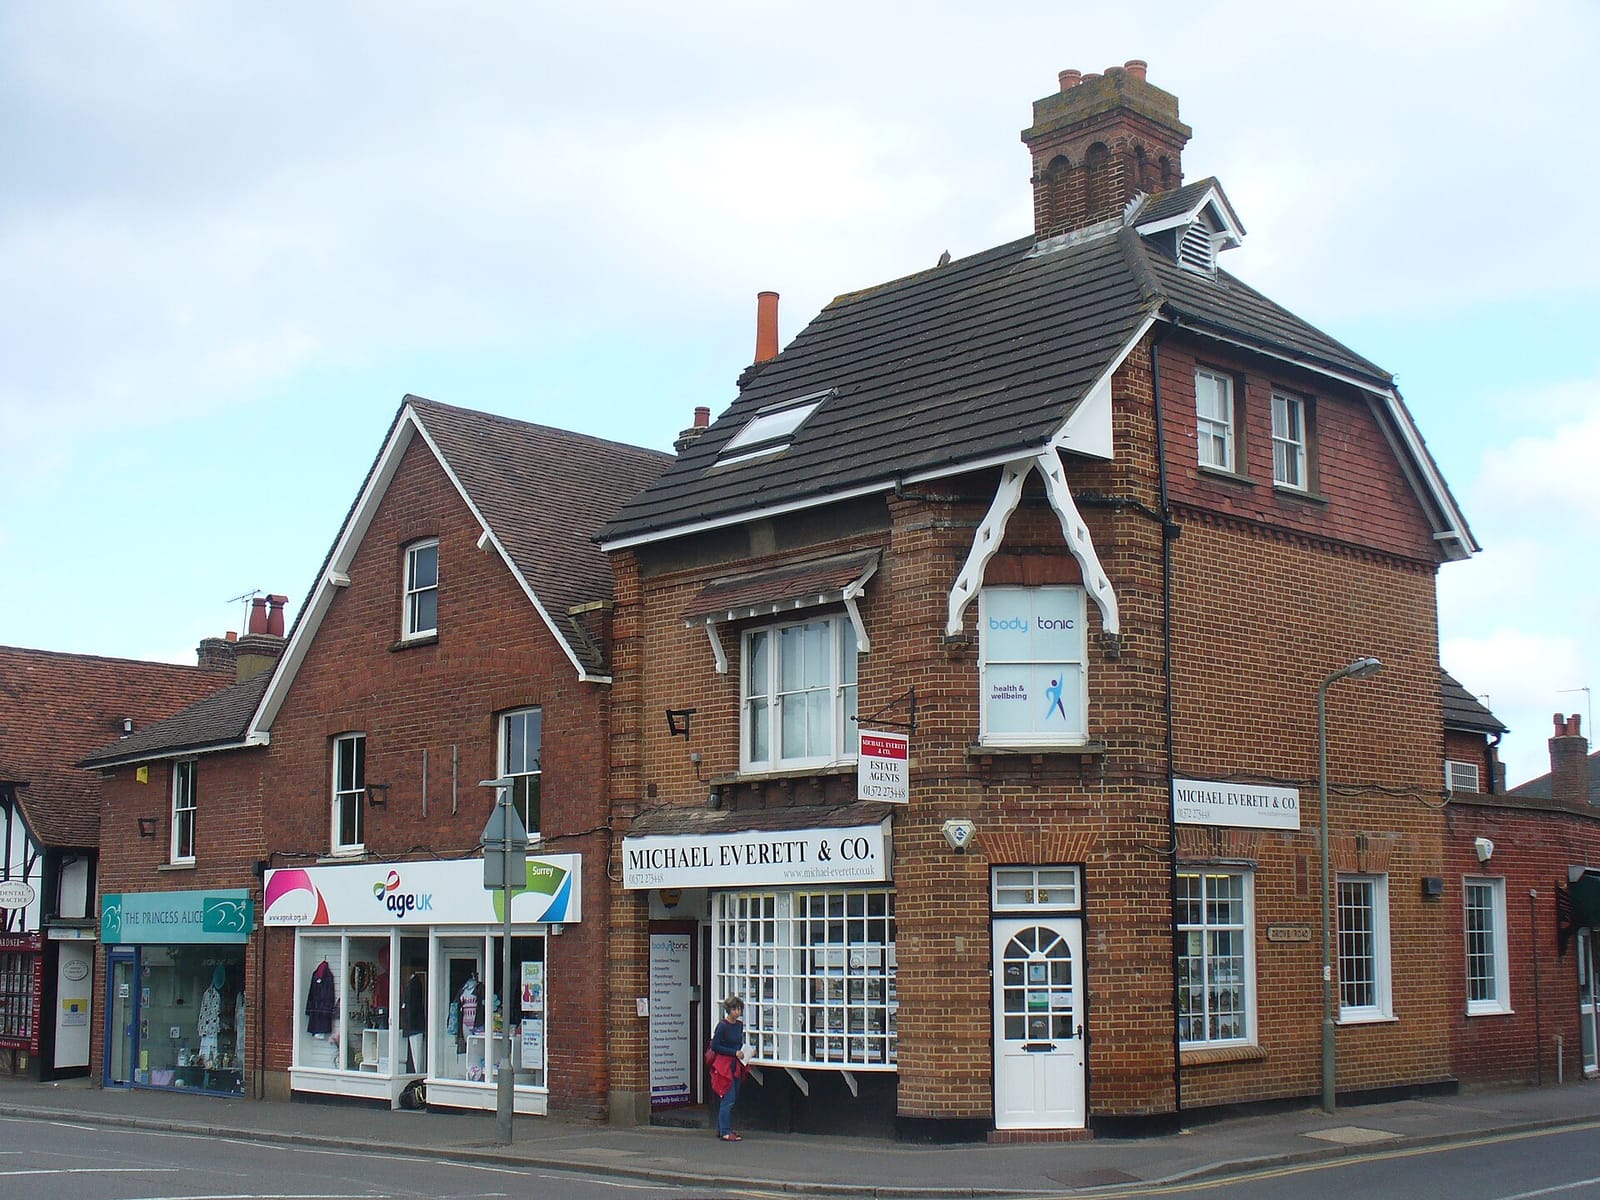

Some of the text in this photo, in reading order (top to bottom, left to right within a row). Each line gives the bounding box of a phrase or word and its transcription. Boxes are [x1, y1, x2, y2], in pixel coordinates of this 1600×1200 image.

[989, 616, 1074, 633] body tonic
[991, 693, 1027, 701] wellbeing
[862, 739, 906, 750] MICHAEL EVERETT
[870, 760, 899, 772] ESTATE
[869, 772, 900, 783] AGENTS
[863, 784, 882, 797] 01372
[1177, 789, 1298, 810] MICHAEL EVERETT & CO.
[629, 837, 875, 870] MICHAEL EVERETT & CO.
[532, 866, 554, 878] Surrey
[125, 910, 204, 925] THE PRINCESS ALICE
[672, 941, 689, 949] tonic
